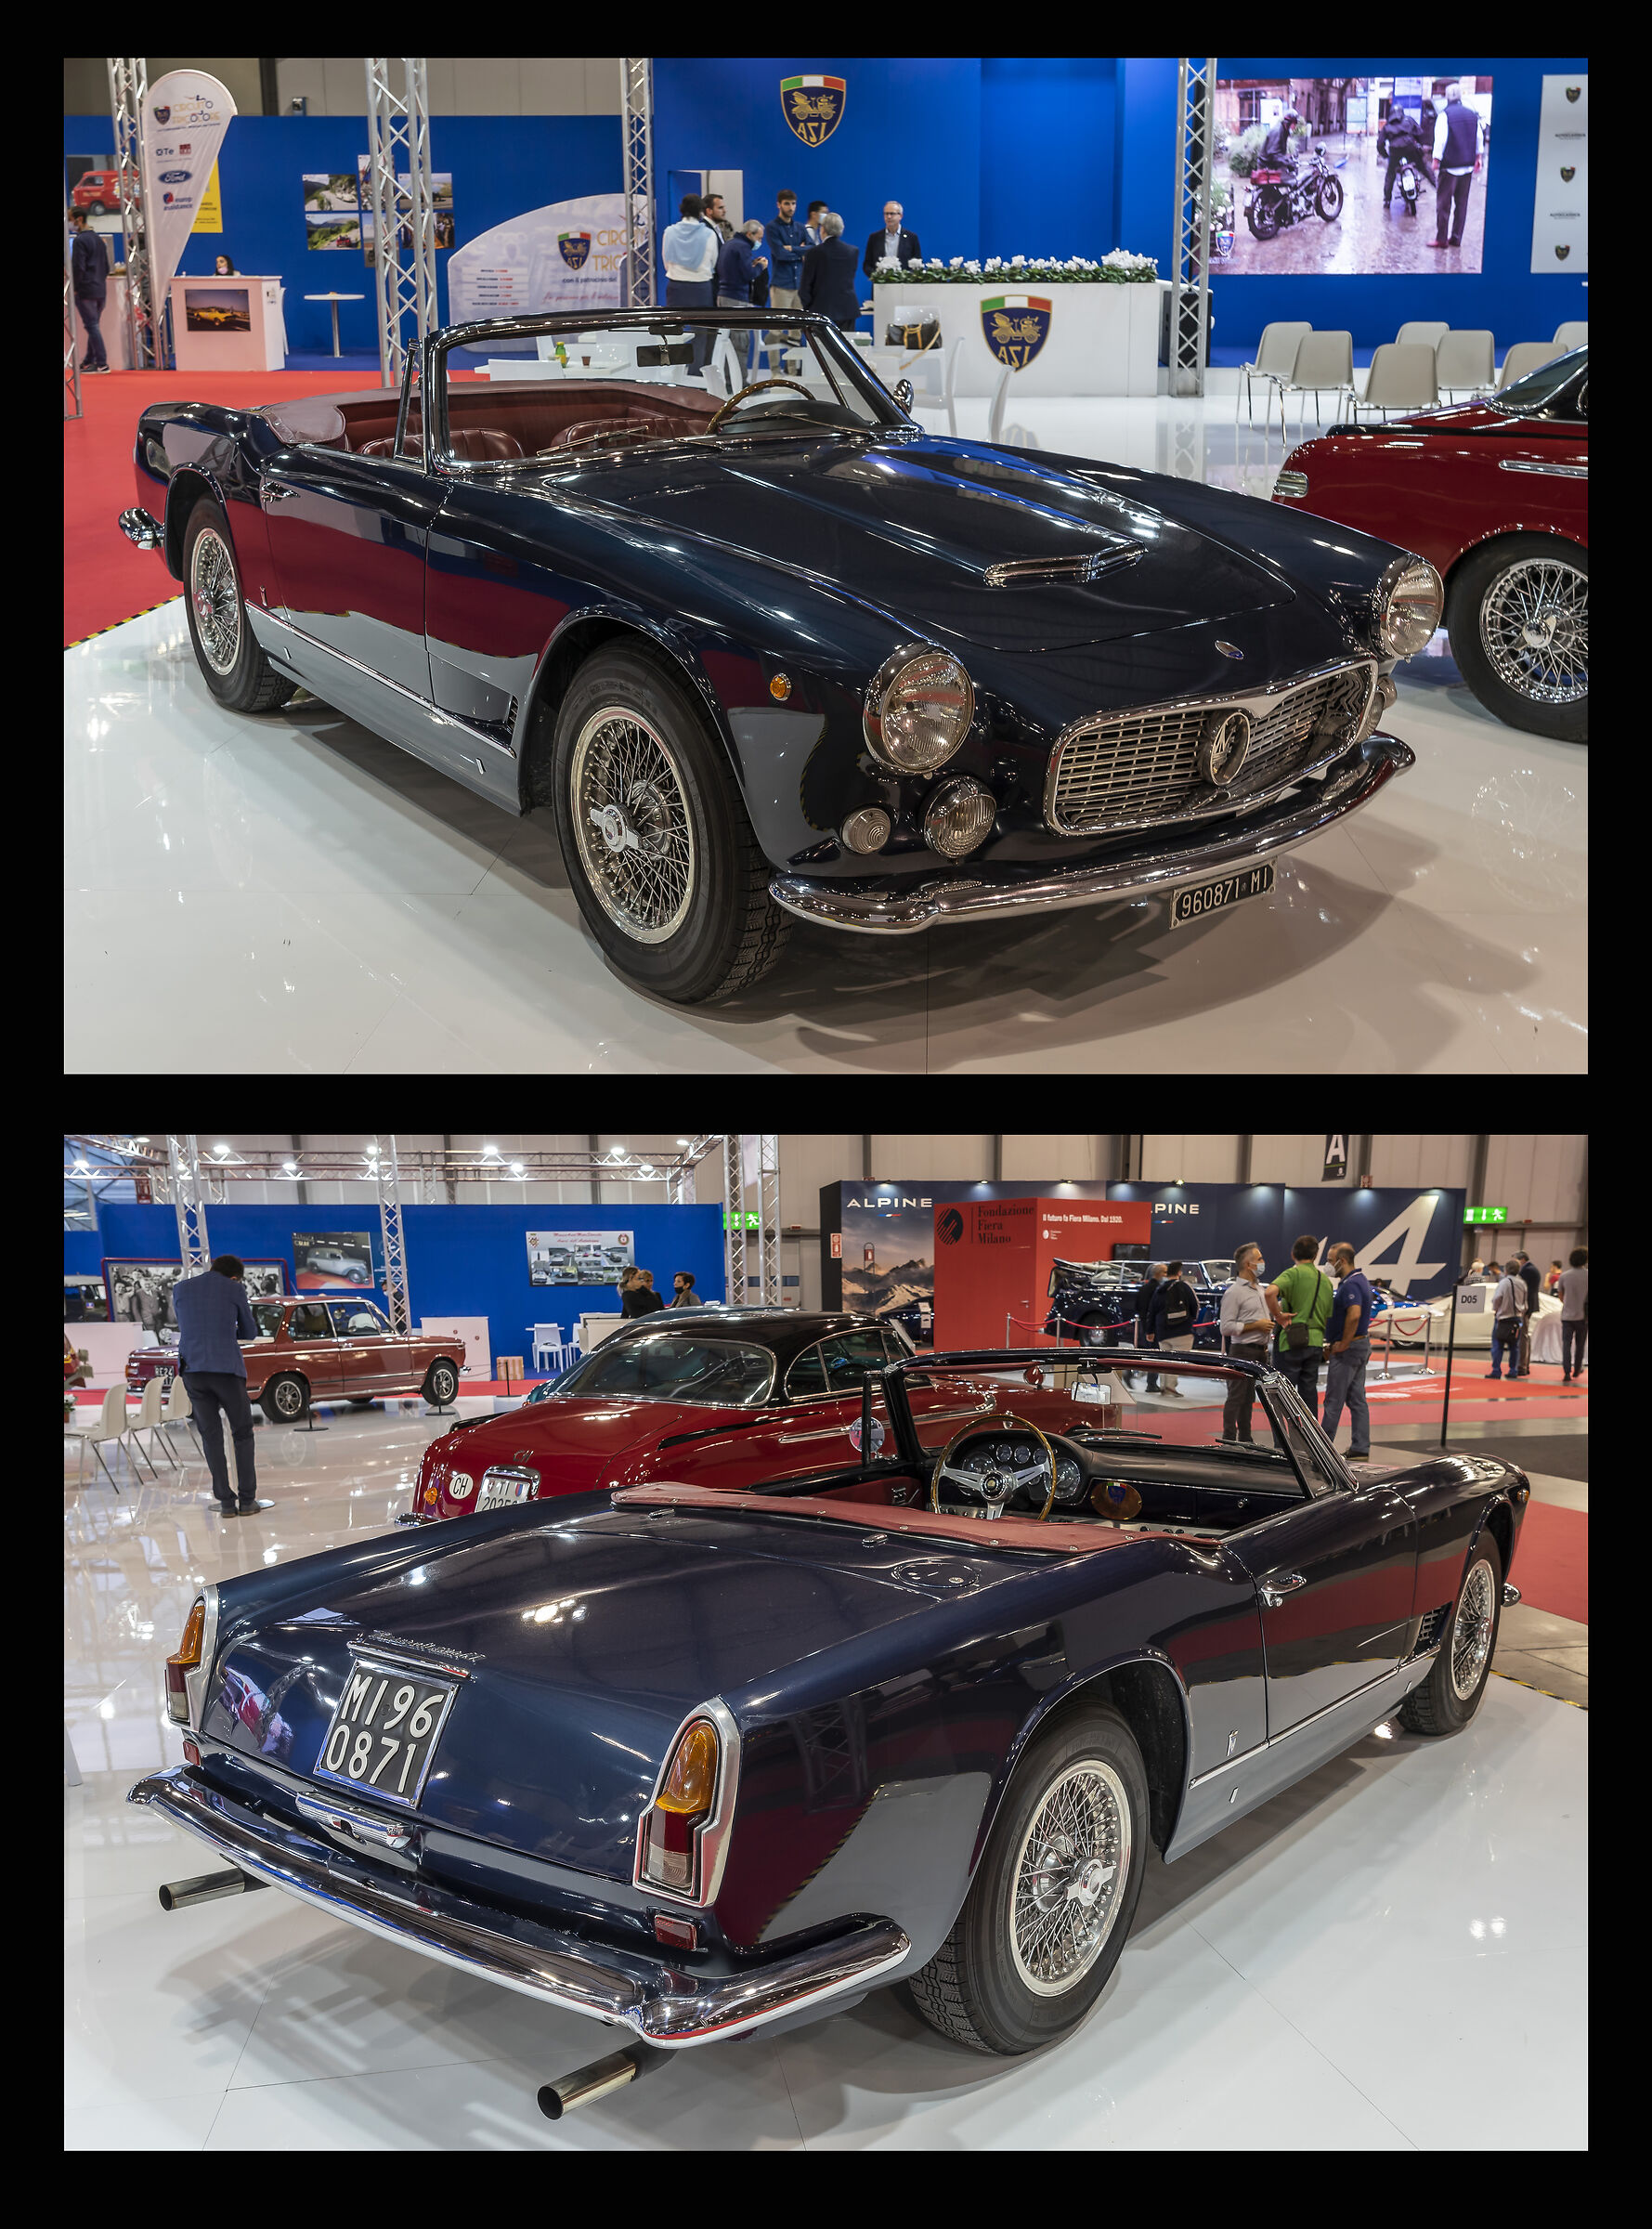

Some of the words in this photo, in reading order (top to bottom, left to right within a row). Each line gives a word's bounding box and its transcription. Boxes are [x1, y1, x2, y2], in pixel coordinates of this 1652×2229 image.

[798, 122, 826, 142] ASI
[998, 345, 1030, 368] ASI
[1181, 877, 1240, 918] 960871
[1250, 867, 1268, 893] MI
[1326, 1135, 1346, 1165] A
[846, 1197, 933, 1208] ALPINE
[1151, 1203, 1200, 1215] PINE
[978, 1204, 1034, 1218] Fondazione
[978, 1219, 1003, 1231] Fiera
[978, 1232, 1011, 1245] Milano
[1461, 1296, 1477, 1304] D05
[452, 1478, 469, 1496] CH
[326, 1724, 417, 1793] 0871
